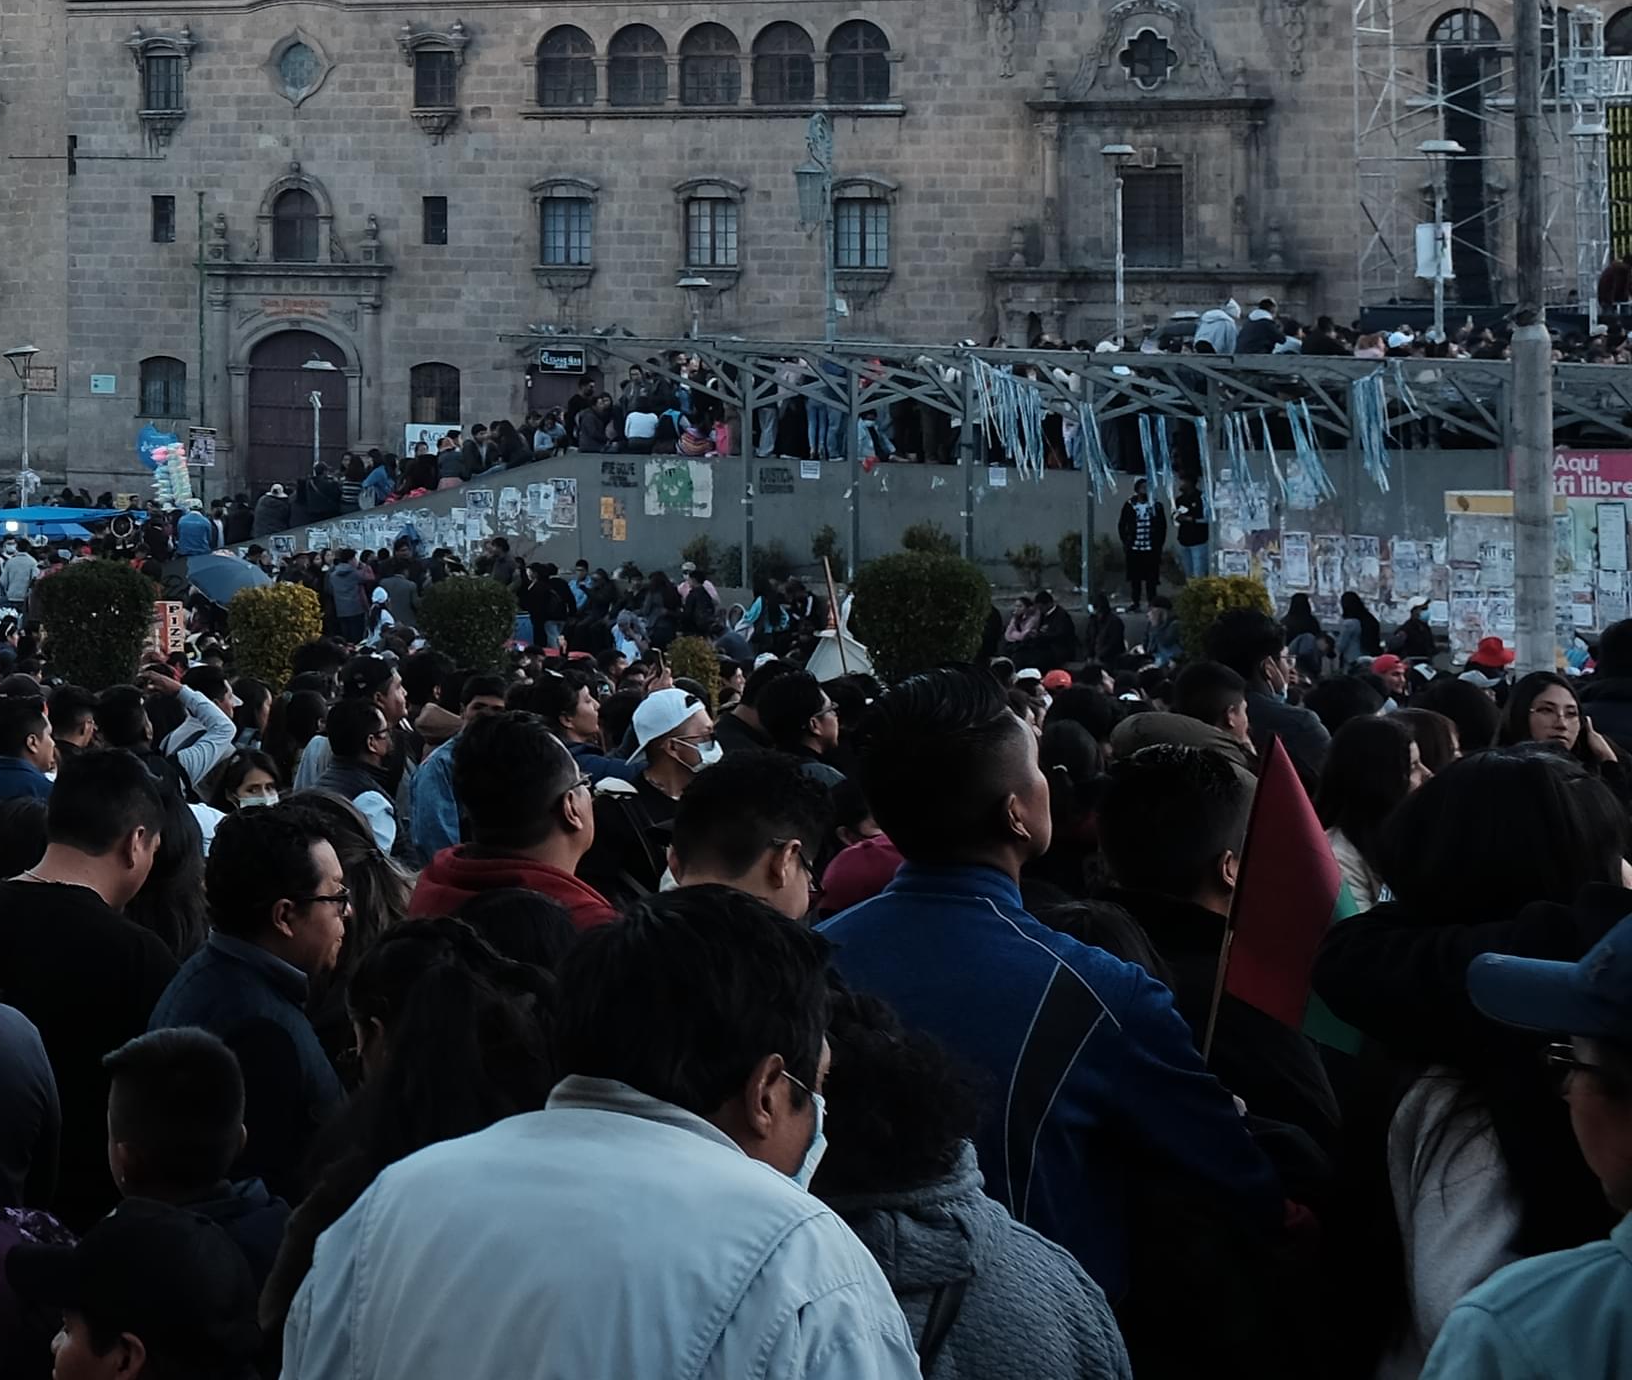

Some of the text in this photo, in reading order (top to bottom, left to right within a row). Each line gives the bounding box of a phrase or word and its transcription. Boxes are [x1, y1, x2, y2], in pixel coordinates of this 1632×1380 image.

[1553, 453, 1599, 475] Aquí
[1553, 474, 1632, 496] ifi libre
[168, 605, 182, 648] PIZZ
